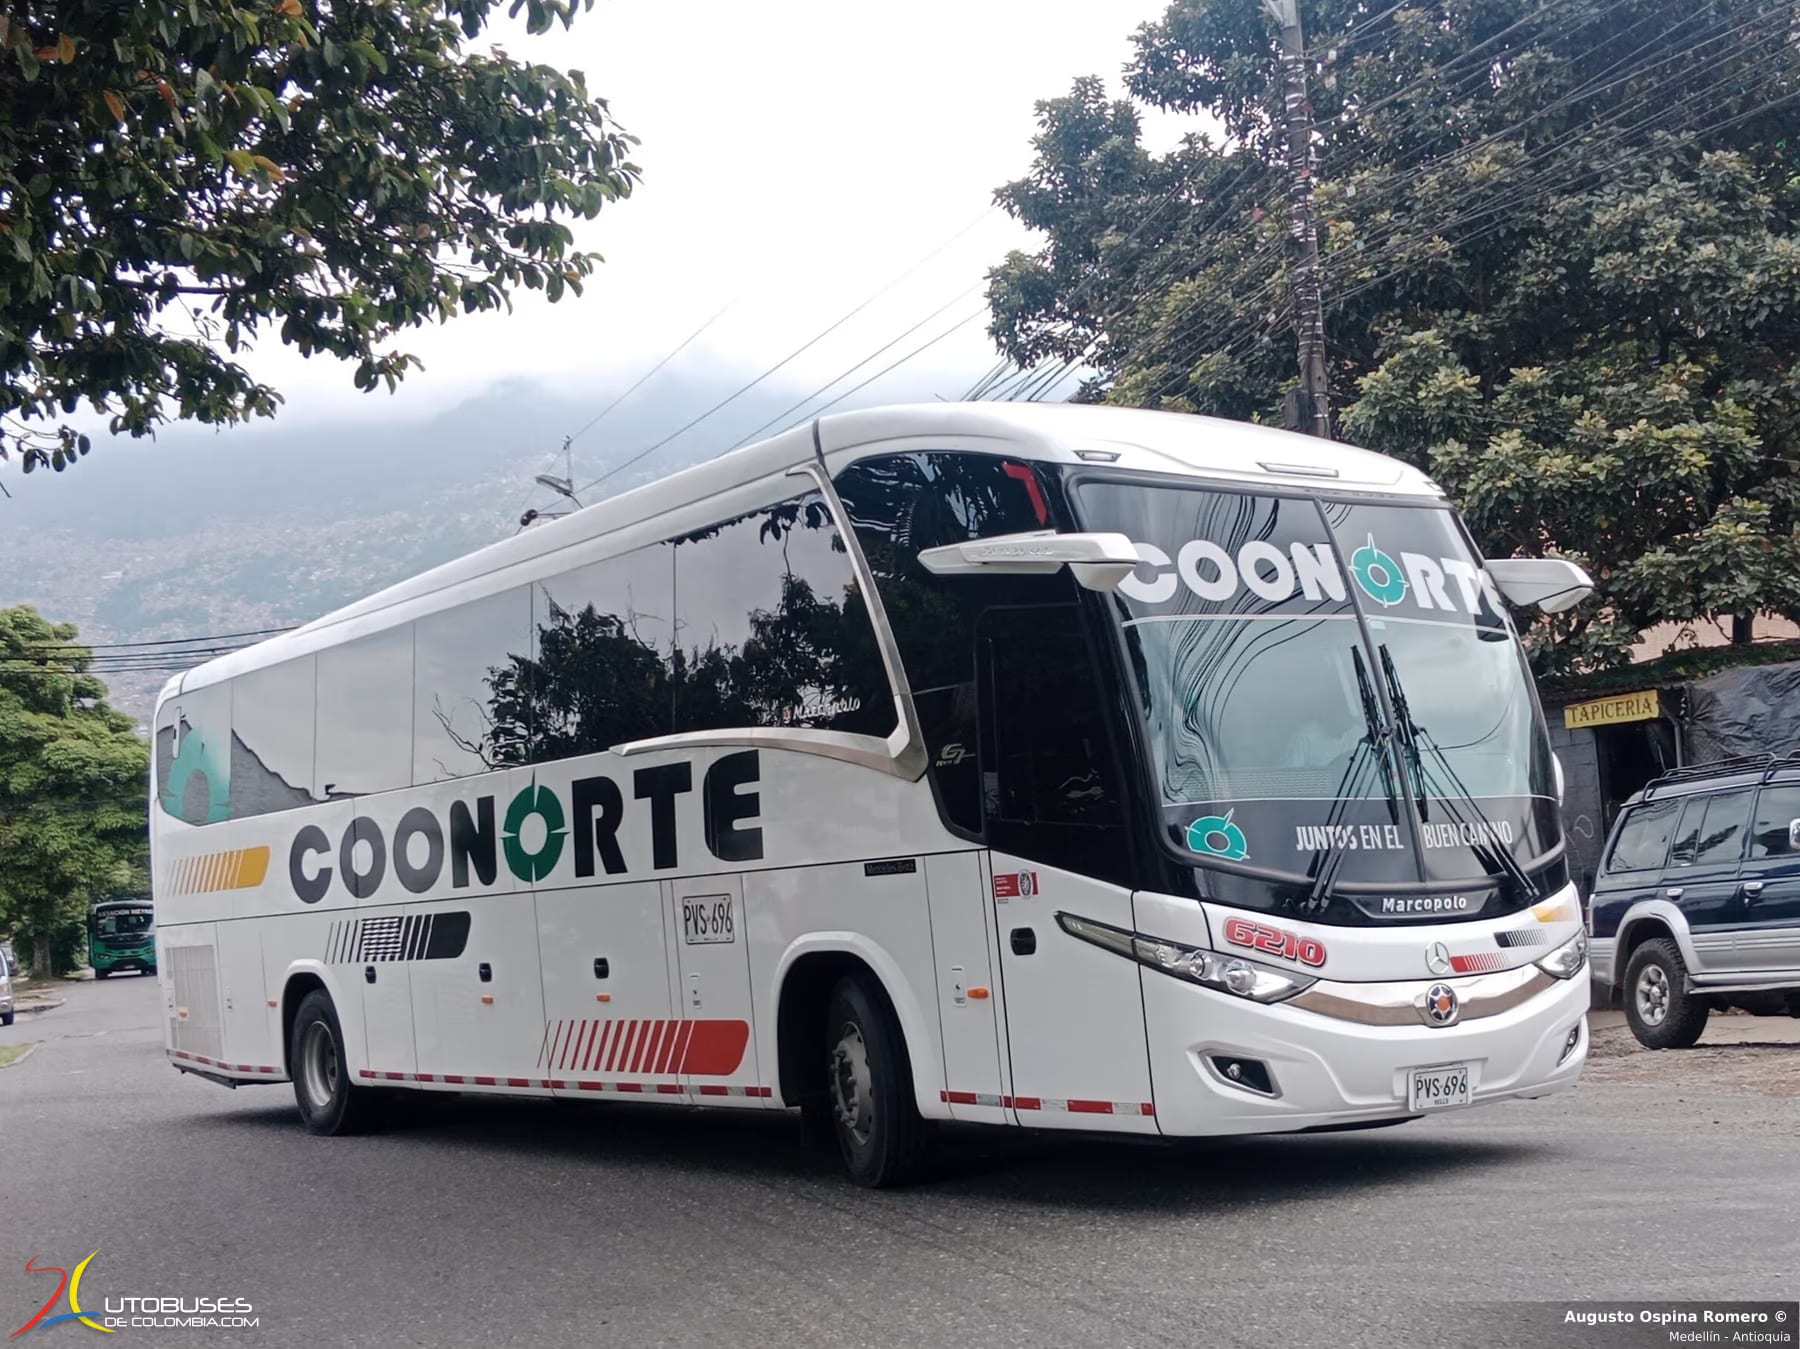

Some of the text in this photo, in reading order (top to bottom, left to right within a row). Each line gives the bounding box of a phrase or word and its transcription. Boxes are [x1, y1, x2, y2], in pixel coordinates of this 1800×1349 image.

[289, 749, 765, 904] COONORTE
[1296, 824, 1405, 851] JUNTOS EN EL
[1422, 823, 1460, 848] BUEN
[1382, 896, 1467, 914] Marcopolo
[1224, 917, 1327, 967] 6210
